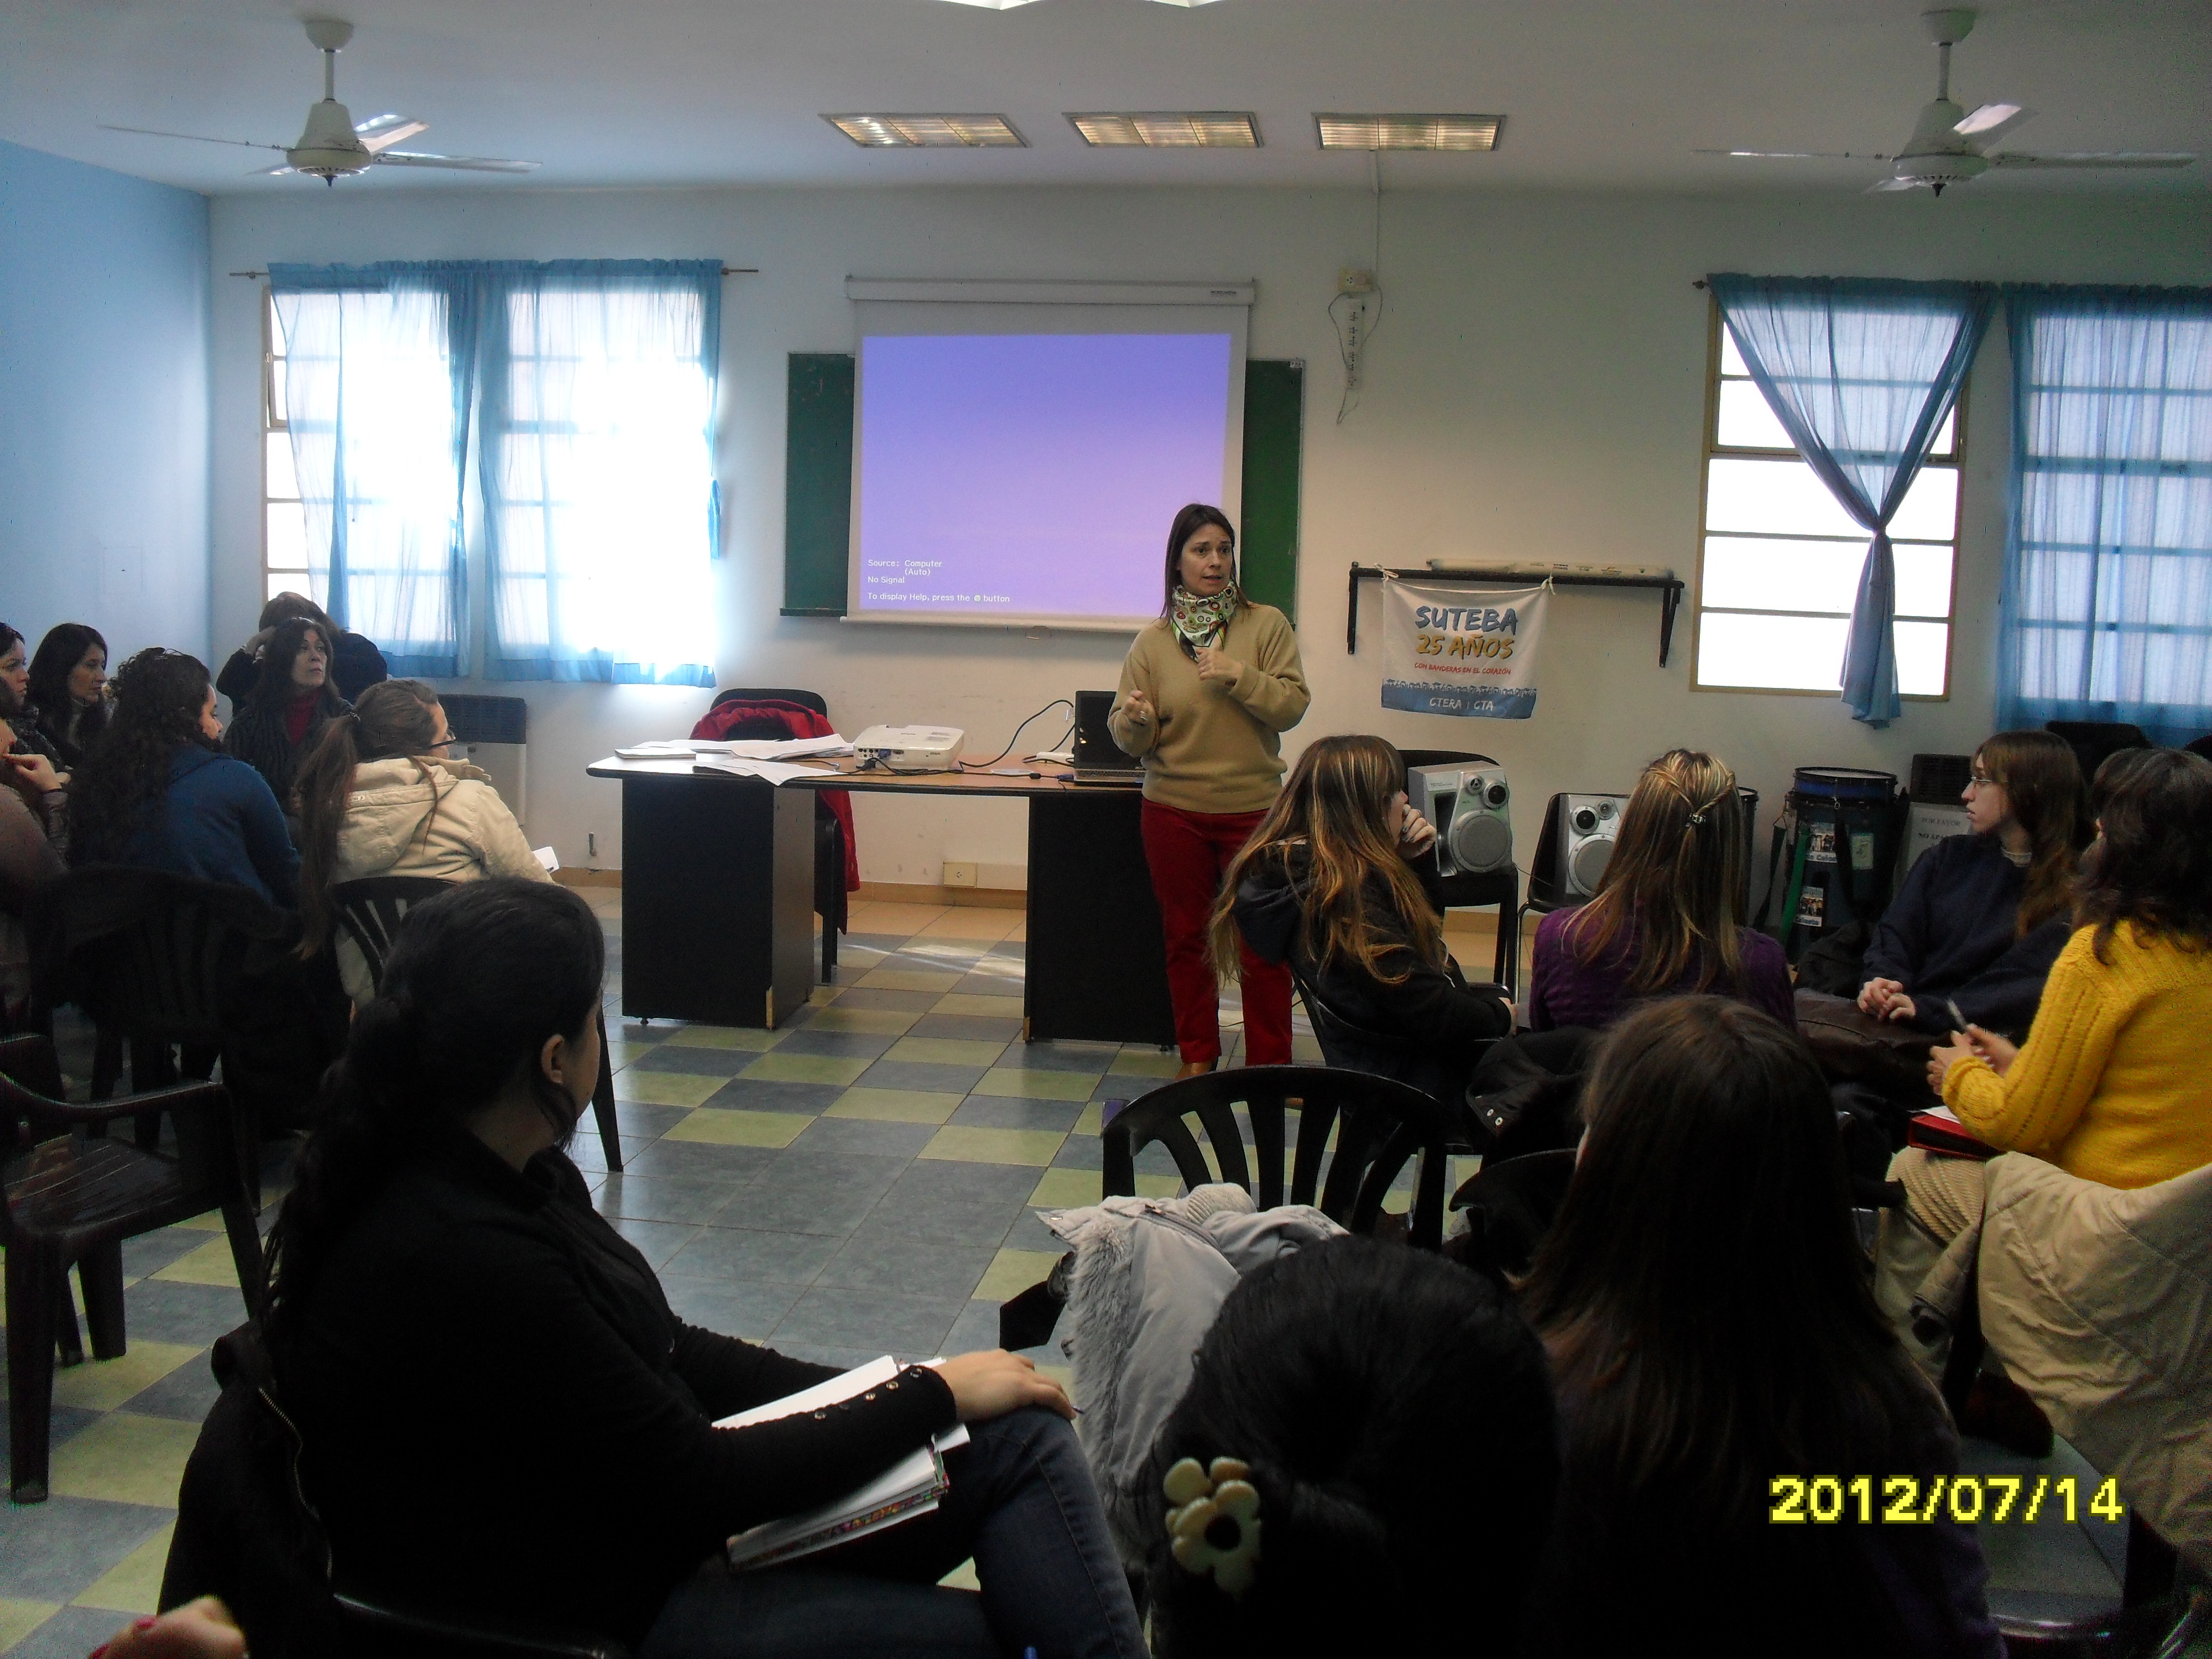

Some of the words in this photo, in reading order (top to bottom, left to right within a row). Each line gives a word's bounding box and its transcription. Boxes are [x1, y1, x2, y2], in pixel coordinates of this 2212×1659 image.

[880, 593, 907, 601] display
[910, 593, 929, 602] Help,
[1415, 606, 1519, 636] SUTEBA
[1416, 634, 1445, 655] 25
[1448, 634, 1515, 660] AÑOS
[1428, 664, 1462, 673] BANDERAS
[1430, 697, 1462, 709] CTERA
[1474, 701, 1494, 712] CTA
